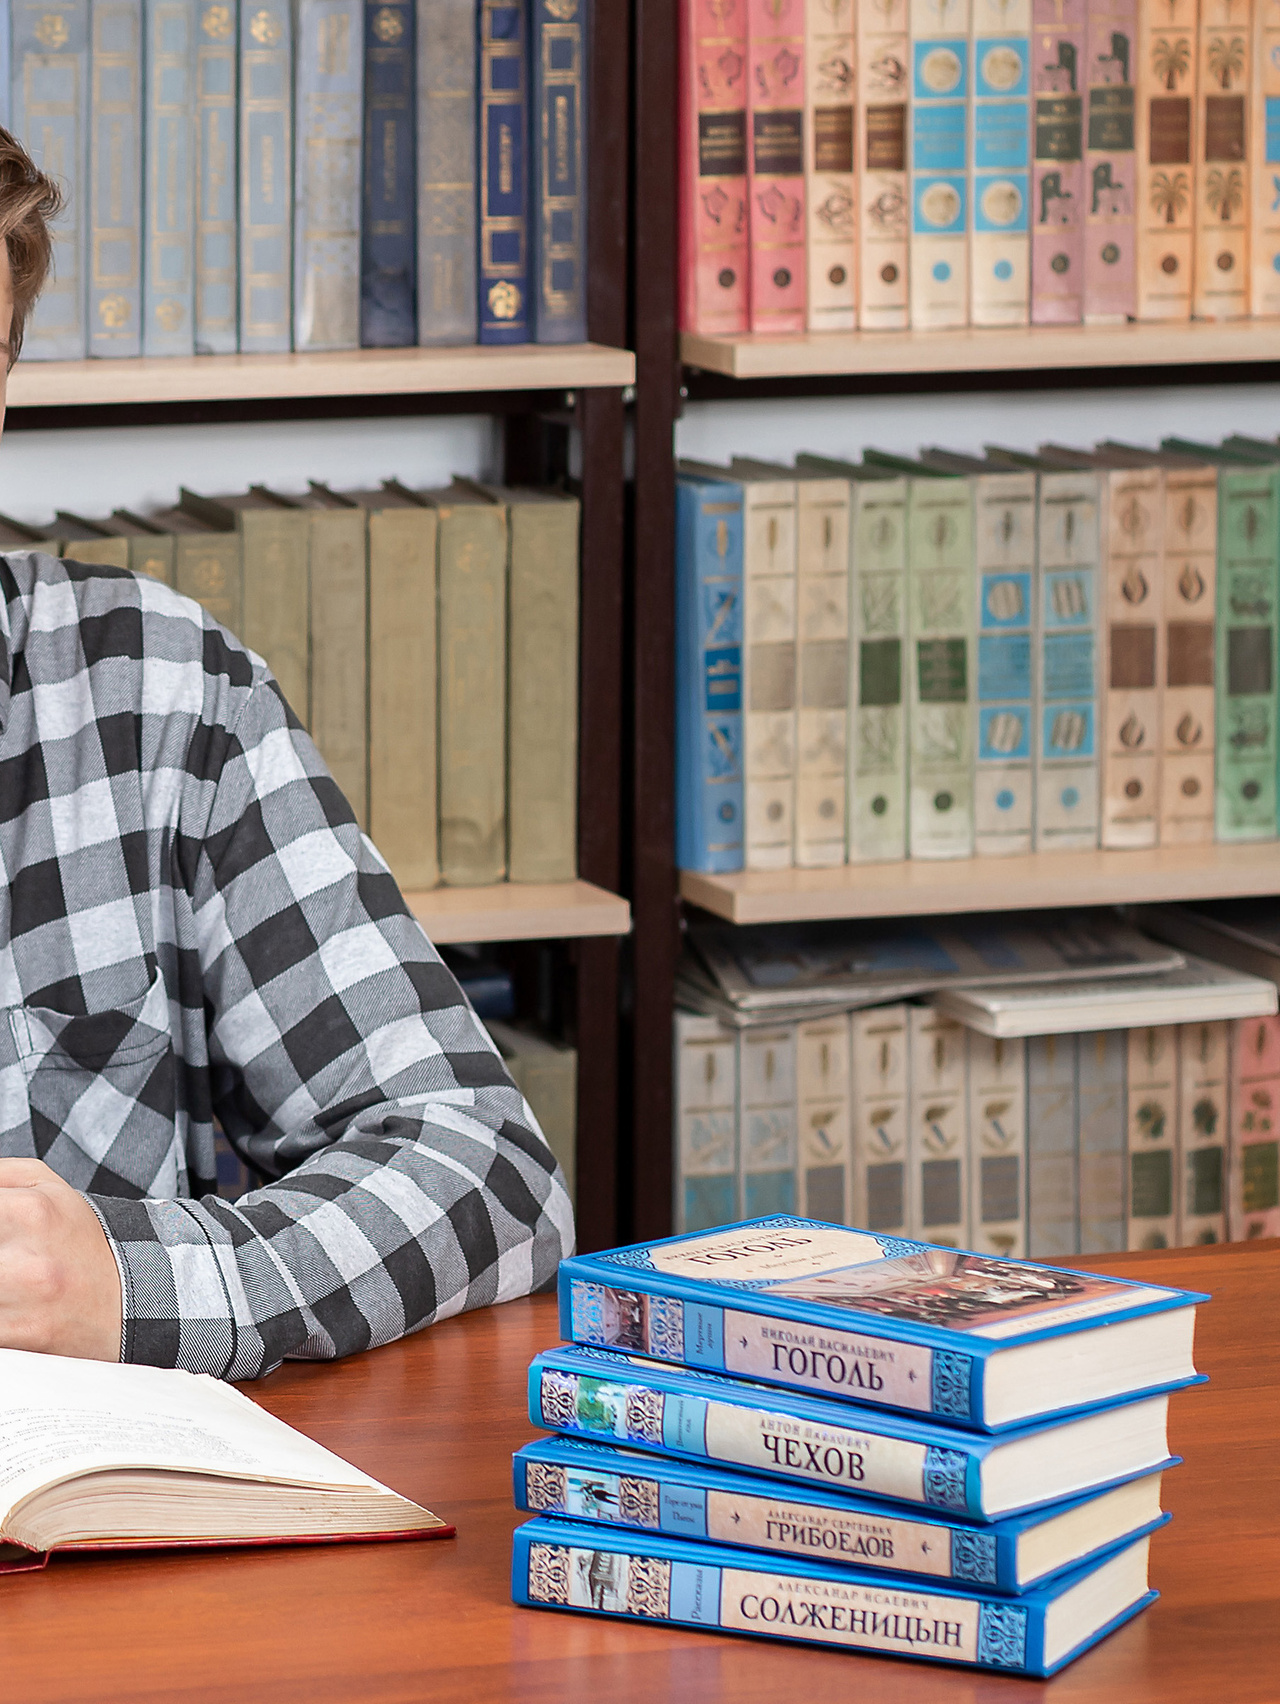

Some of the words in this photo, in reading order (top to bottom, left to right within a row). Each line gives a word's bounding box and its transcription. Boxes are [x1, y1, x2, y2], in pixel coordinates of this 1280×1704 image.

[687, 1237, 813, 1266] ГОГОЛЬ
[761, 1326, 815, 1347] НИКОЛАЙ
[819, 1337, 896, 1364] ВАСИЛЬЕВИЧ
[771, 1343, 884, 1391] ГОГОЛЬ
[758, 1417, 801, 1437] АНТОН
[762, 1433, 866, 1482] ЧЕХОВ
[767, 1509, 828, 1528] АЛЕКСАНДР
[766, 1520, 896, 1559] ГРИБОЕДОВ
[777, 1581, 860, 1601] АЛЕКСАНДР
[863, 1592, 930, 1611] ИСАЕВИЧ
[740, 1594, 964, 1649] СОЛЖЕНИЦЫН
